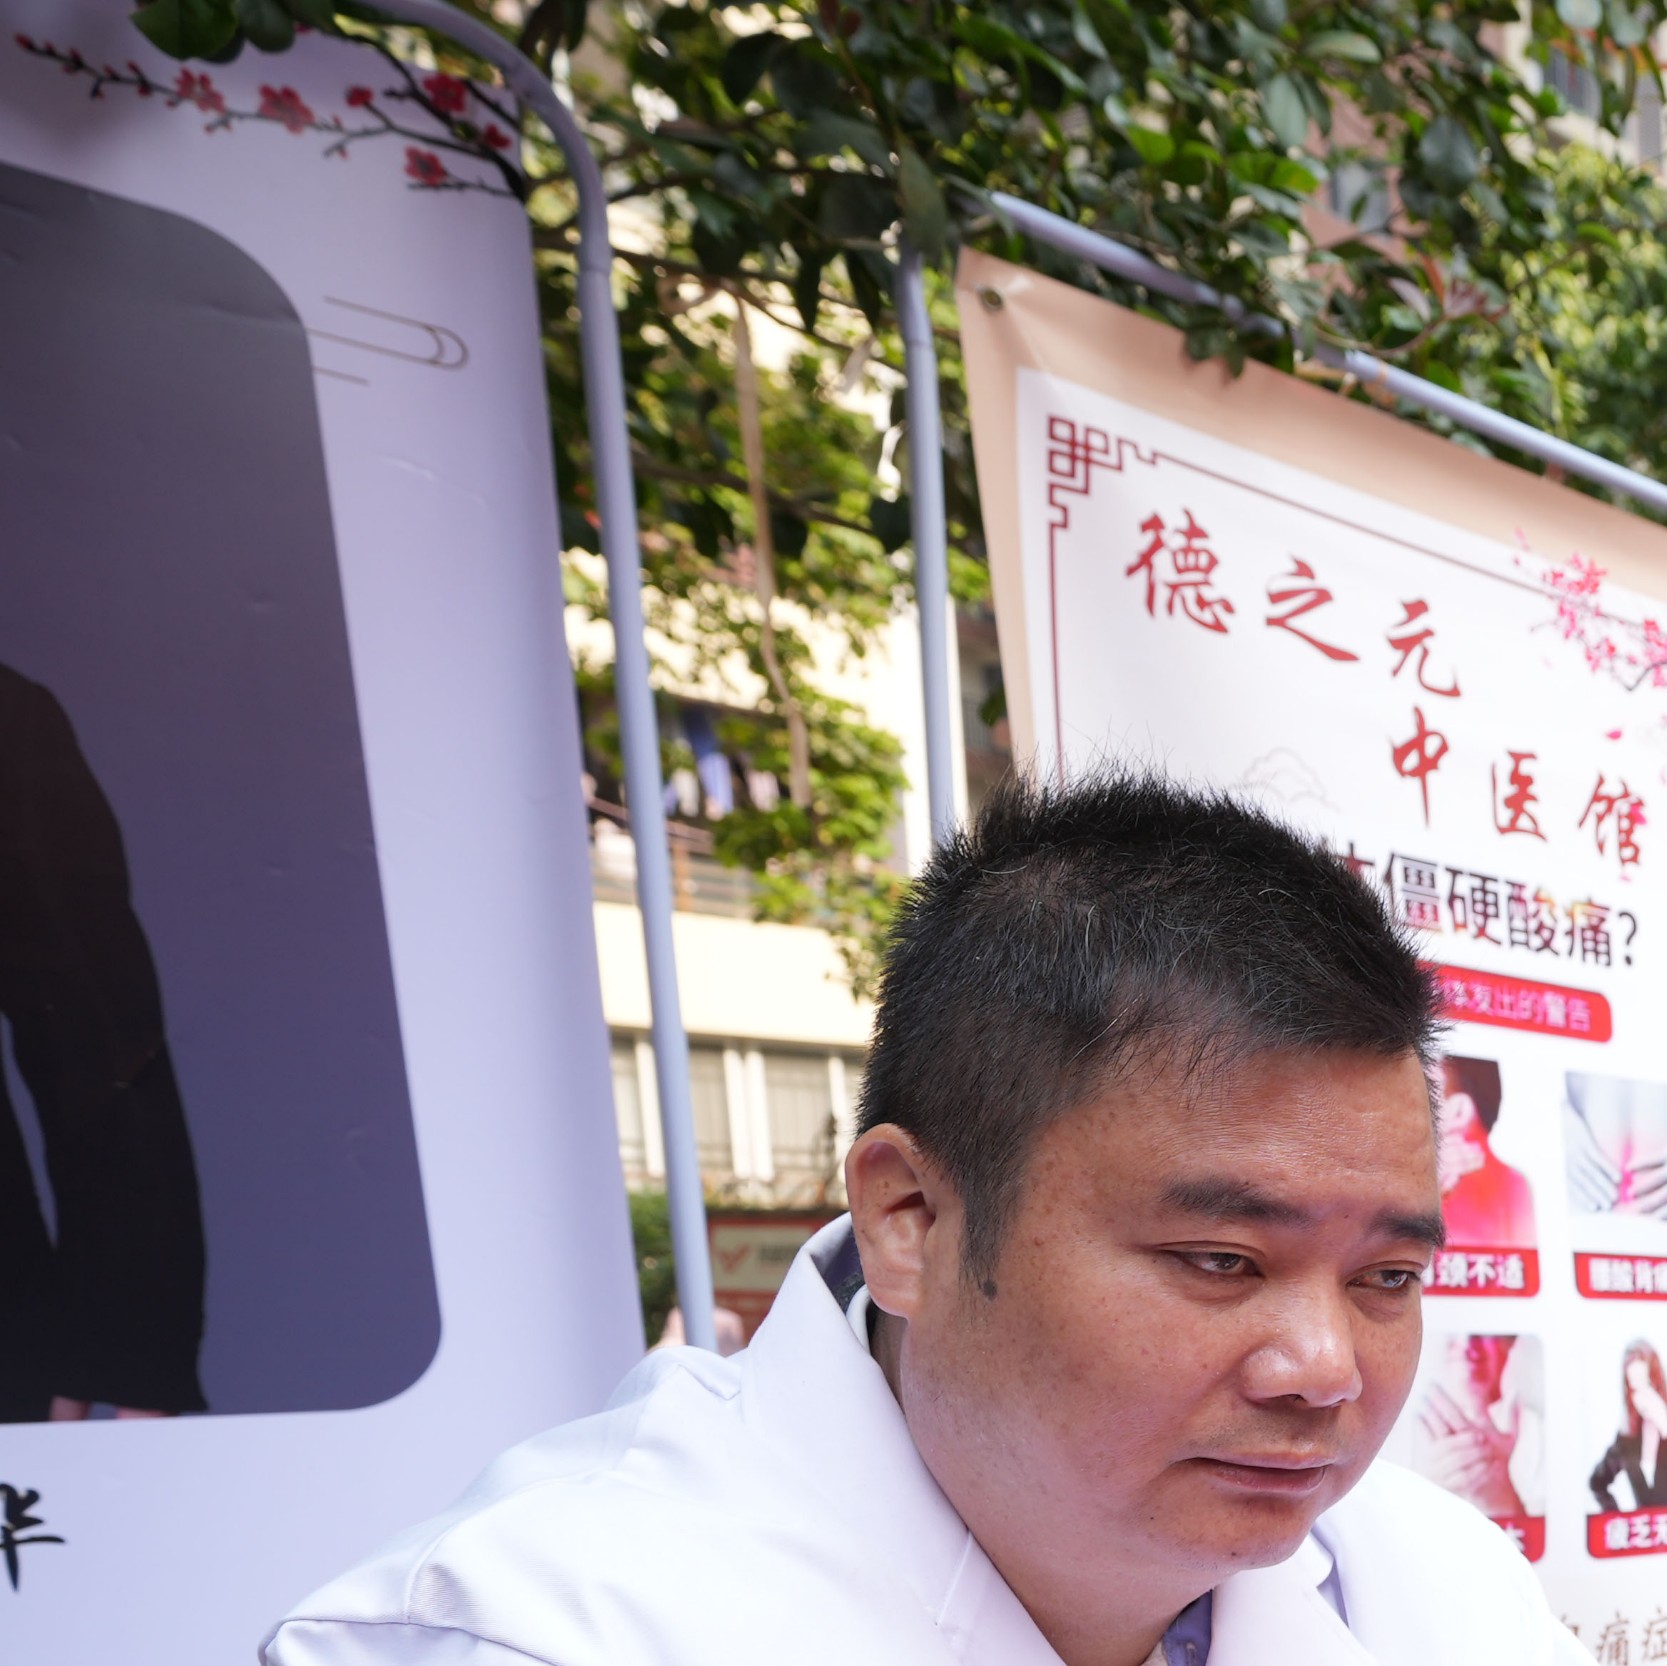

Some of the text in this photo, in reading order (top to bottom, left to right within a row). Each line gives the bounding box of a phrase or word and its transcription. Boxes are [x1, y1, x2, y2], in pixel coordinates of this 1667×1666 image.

[1125, 508, 1462, 699] 德之元
[1389, 705, 1648, 869] 中医馆
